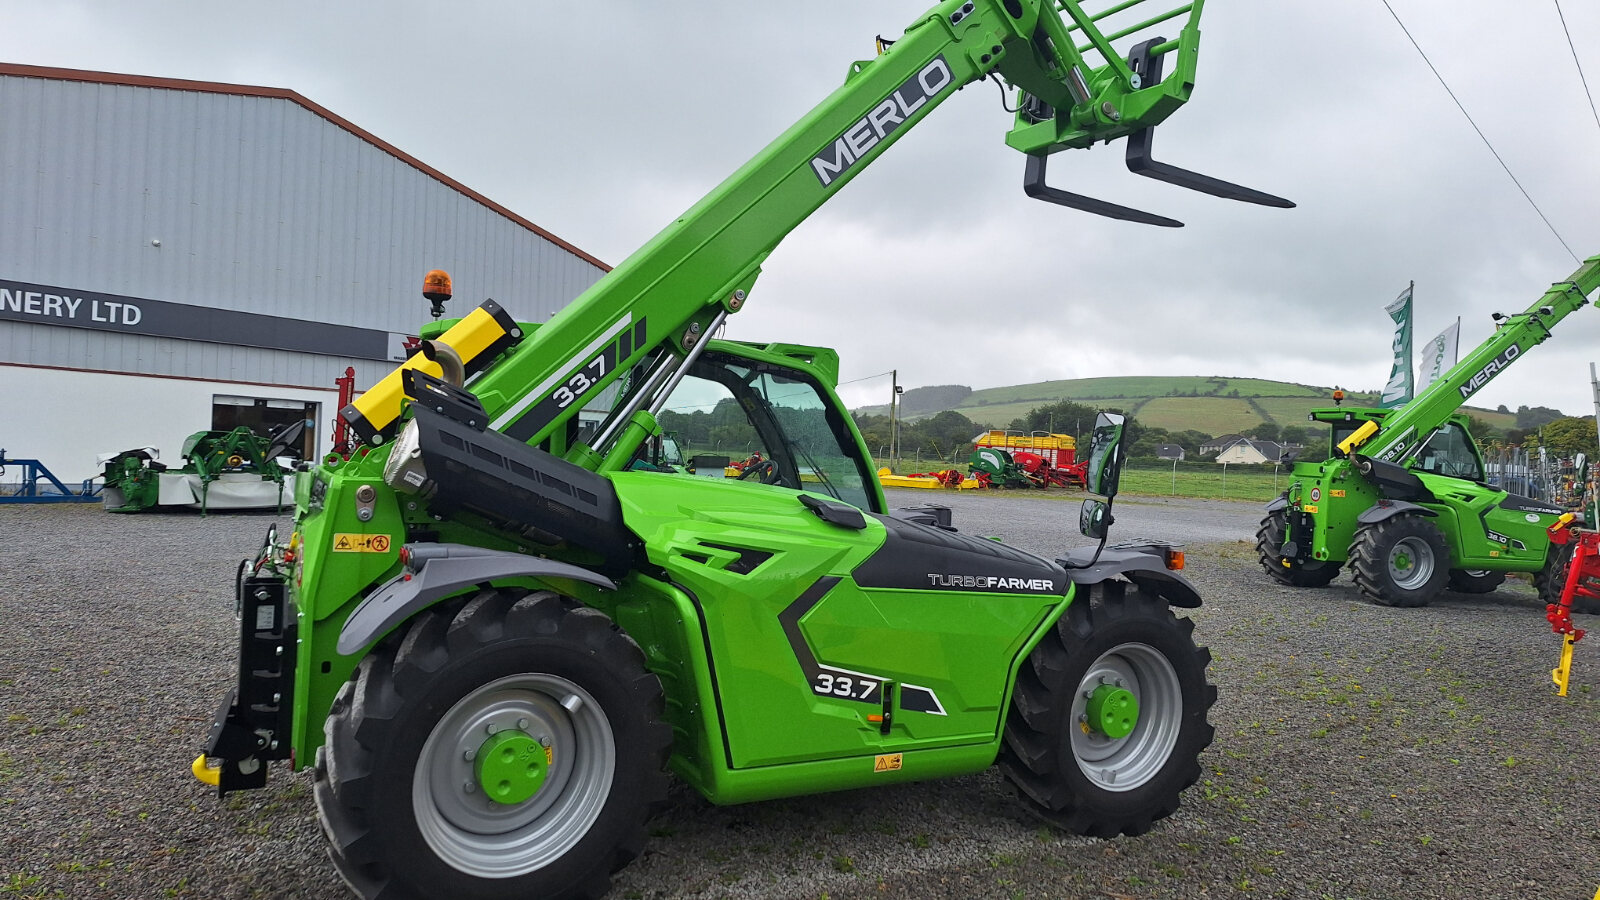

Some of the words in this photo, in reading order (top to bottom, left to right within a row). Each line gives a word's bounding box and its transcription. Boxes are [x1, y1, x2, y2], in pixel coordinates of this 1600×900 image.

[811, 58, 951, 185] MERLO
[0, 288, 83, 319] NERY
[91, 300, 142, 326] LTD
[552, 354, 606, 408] 33.7
[1459, 344, 1519, 397] MERLO
[927, 573, 1054, 591] TURBOFARMER
[814, 673, 878, 700] 33.7
